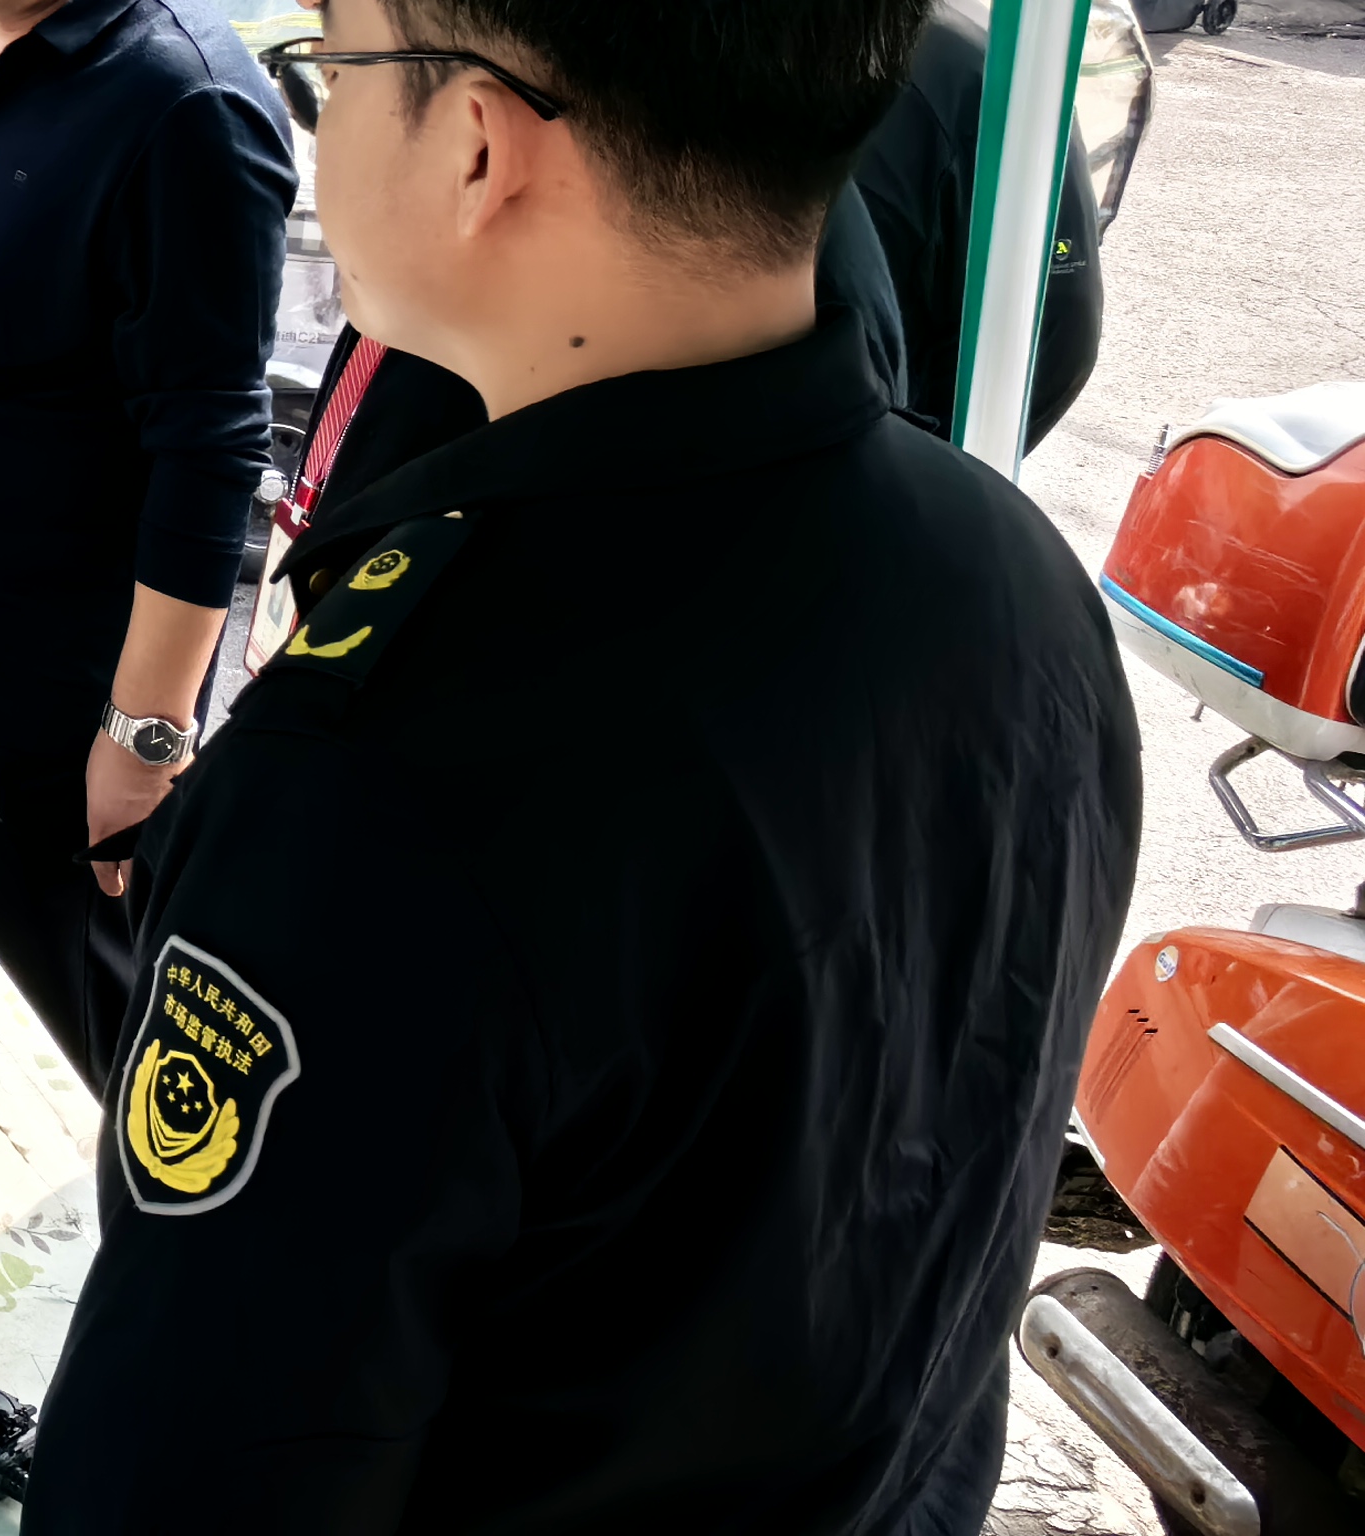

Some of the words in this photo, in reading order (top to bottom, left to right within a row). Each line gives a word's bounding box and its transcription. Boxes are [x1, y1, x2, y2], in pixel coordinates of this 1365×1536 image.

[164, 993, 253, 1075] 市场监管执法
[167, 963, 273, 1057] 中华人民共和国
